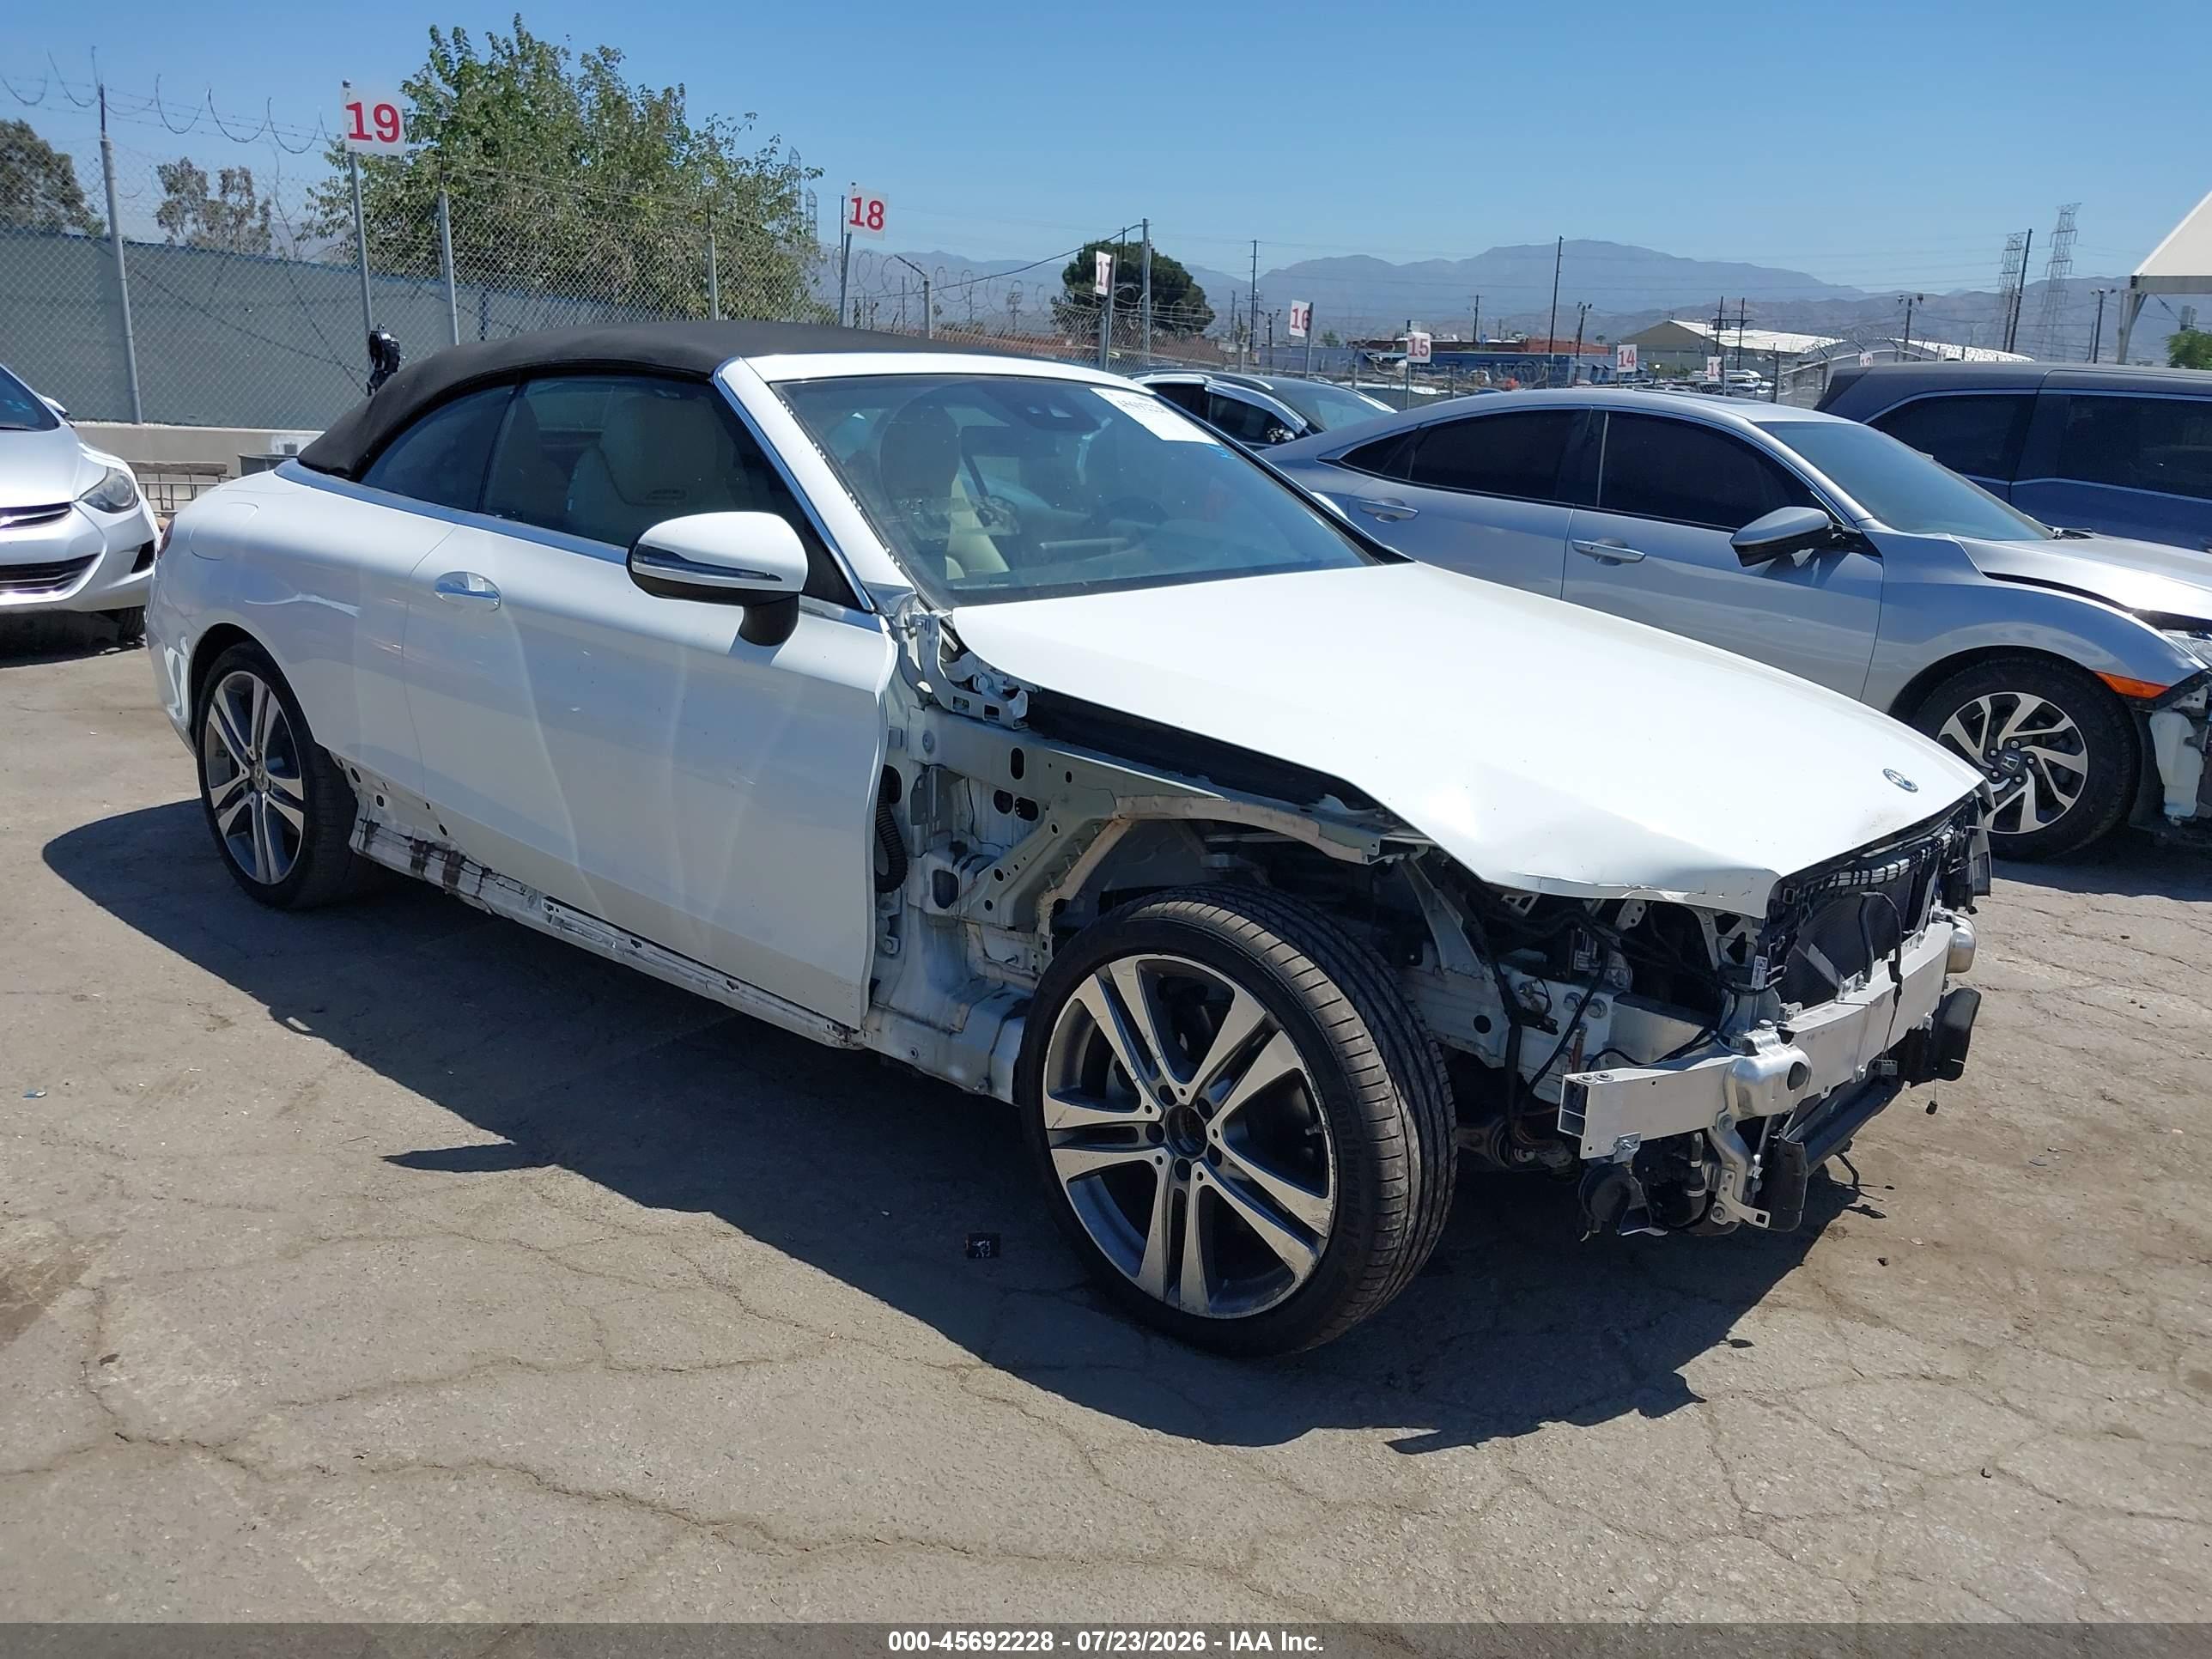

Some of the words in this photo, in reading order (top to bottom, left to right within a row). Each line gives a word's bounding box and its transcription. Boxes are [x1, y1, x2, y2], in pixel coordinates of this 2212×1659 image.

[345, 101, 400, 143] 19
[849, 197, 884, 231] 18
[1291, 307, 1311, 331] 16
[1408, 337, 1429, 357] 15
[1618, 349, 1636, 368] 14
